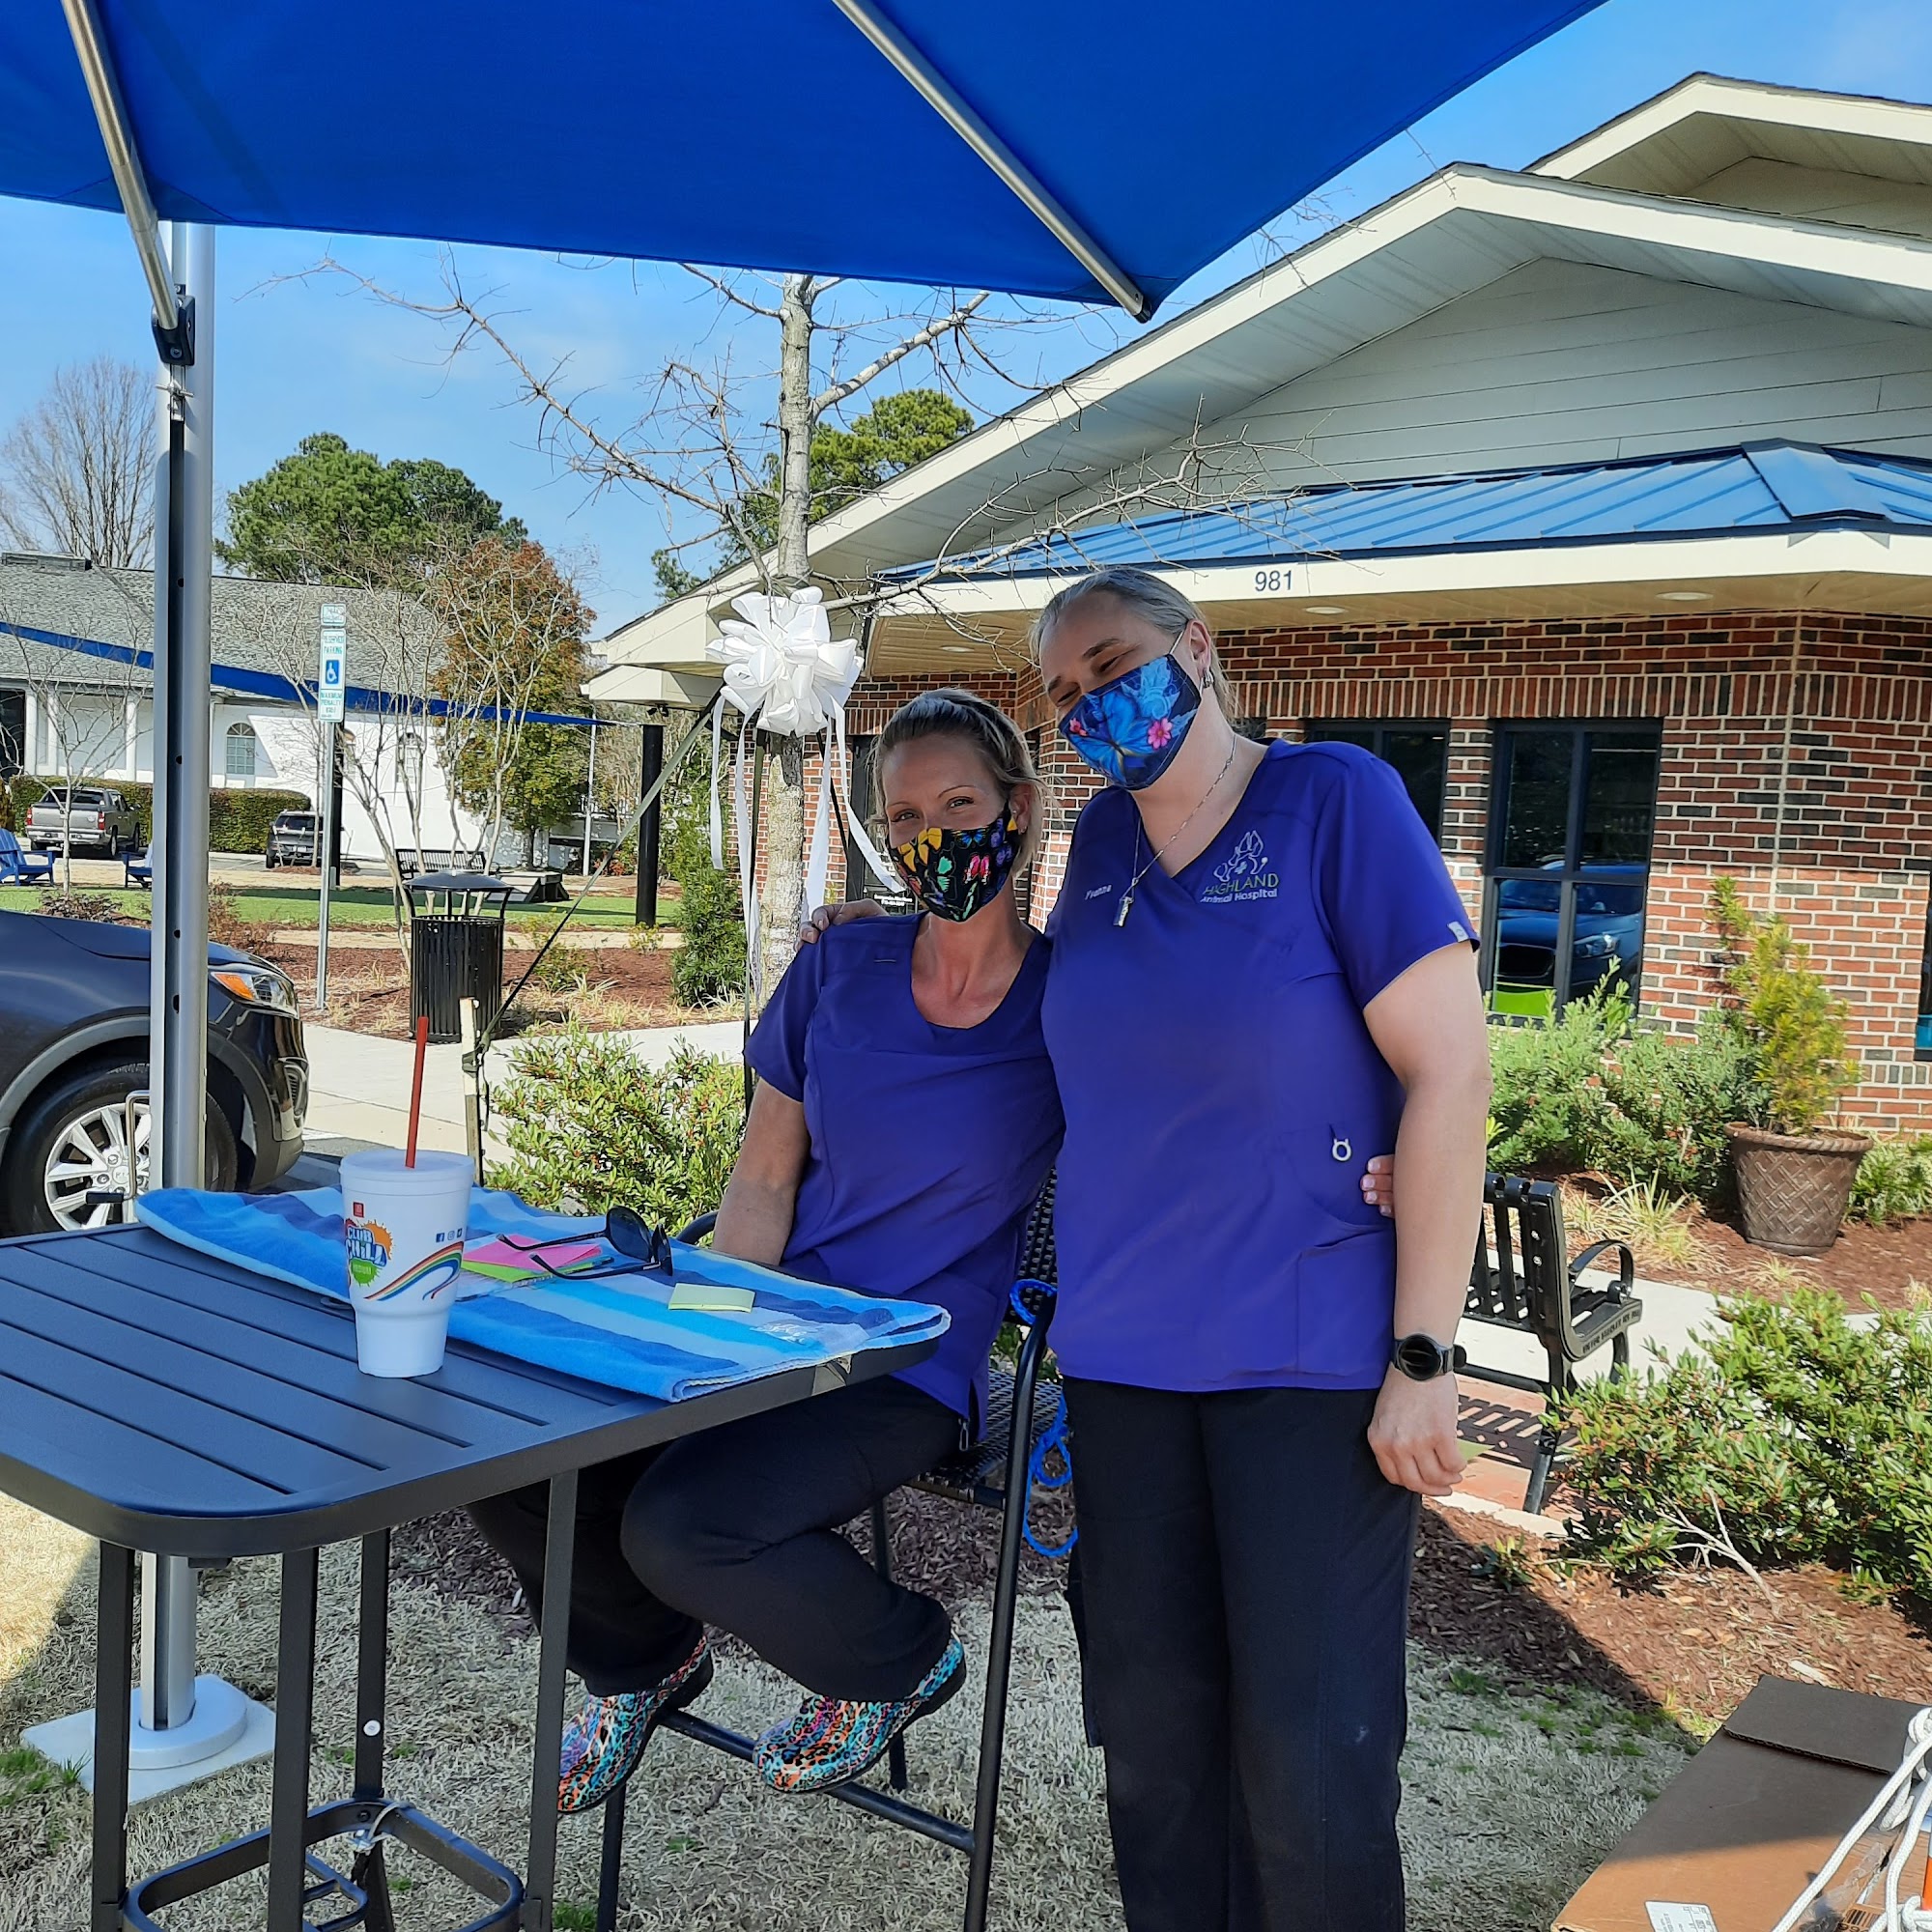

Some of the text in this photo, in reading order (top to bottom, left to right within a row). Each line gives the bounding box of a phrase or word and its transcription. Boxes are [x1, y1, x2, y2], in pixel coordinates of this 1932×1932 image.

[1255, 570, 1292, 592] 981
[324, 646, 343, 655] PARKING
[1203, 873, 1279, 895] HIGHLAND
[1200, 888, 1278, 904] Animal Hospital
[349, 1228, 373, 1243] CLUB
